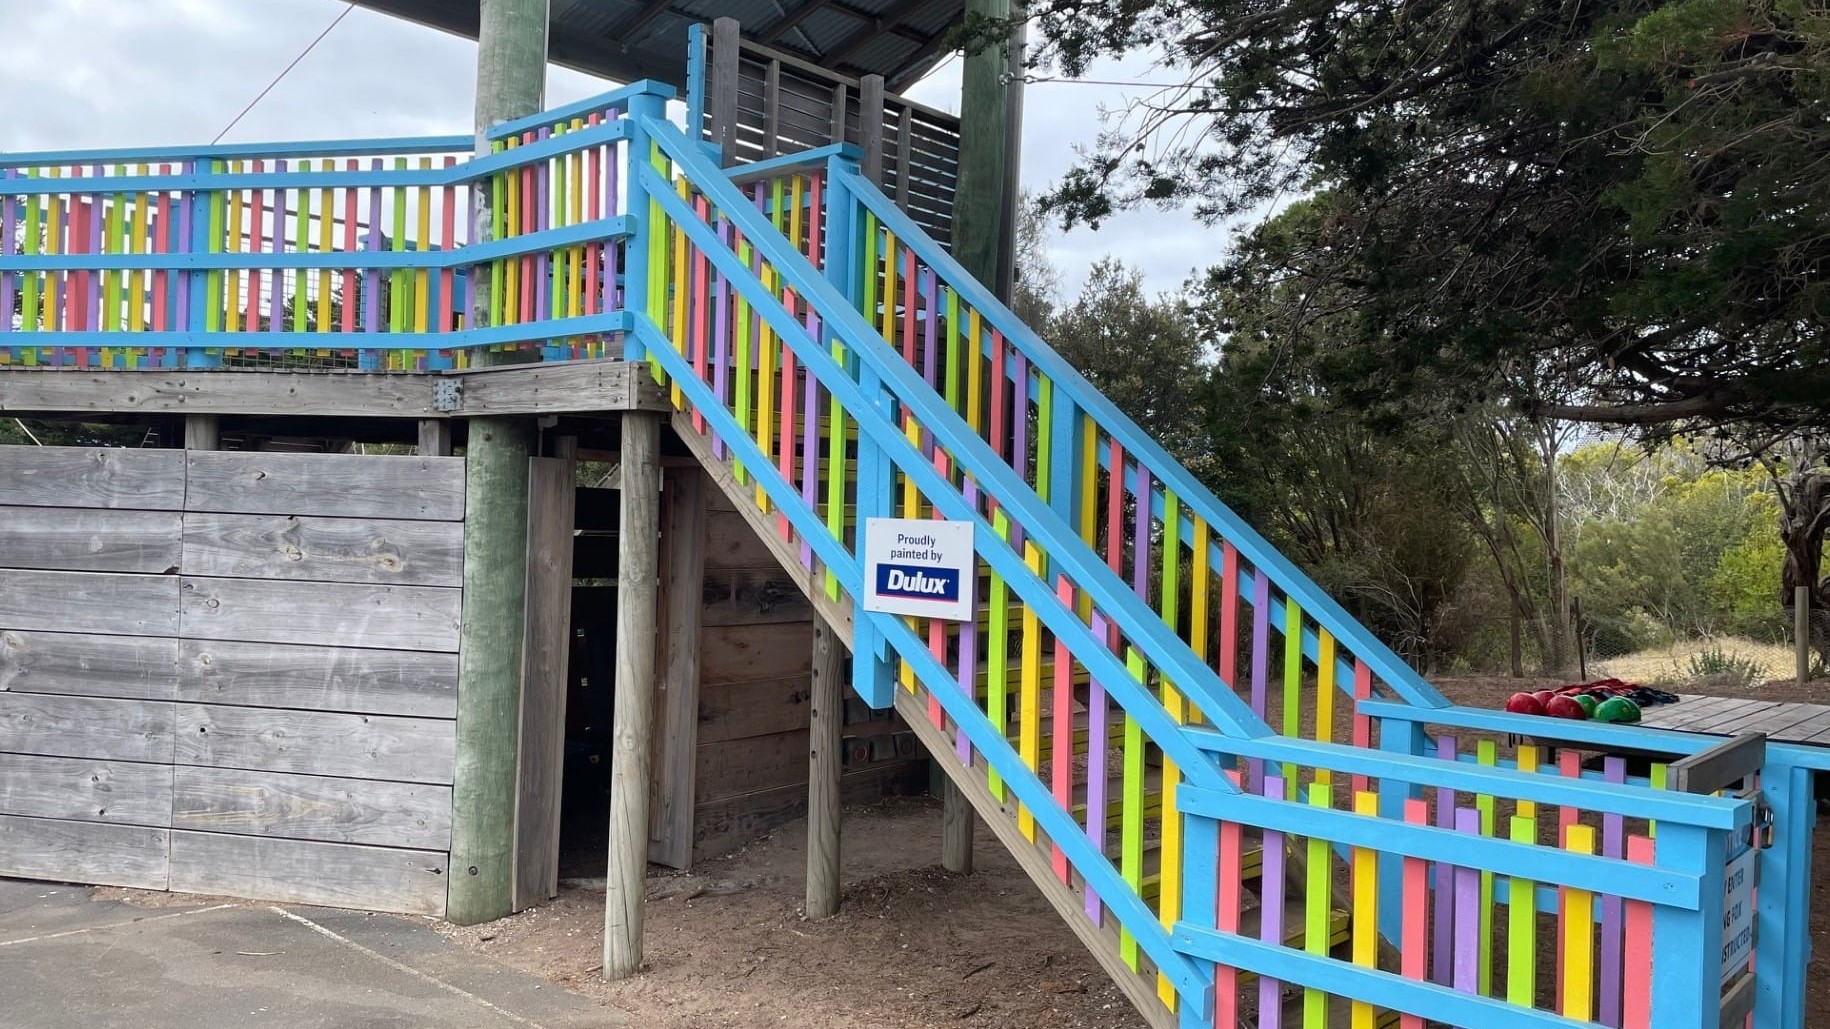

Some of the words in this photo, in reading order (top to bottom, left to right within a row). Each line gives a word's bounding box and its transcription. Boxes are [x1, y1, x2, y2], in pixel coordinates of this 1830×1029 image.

[898, 533, 936, 548] Proudly
[890, 548, 928, 560] painted
[930, 550, 943, 563] by
[887, 569, 947, 594] Dulux
[1727, 867, 1744, 895] ENTER
